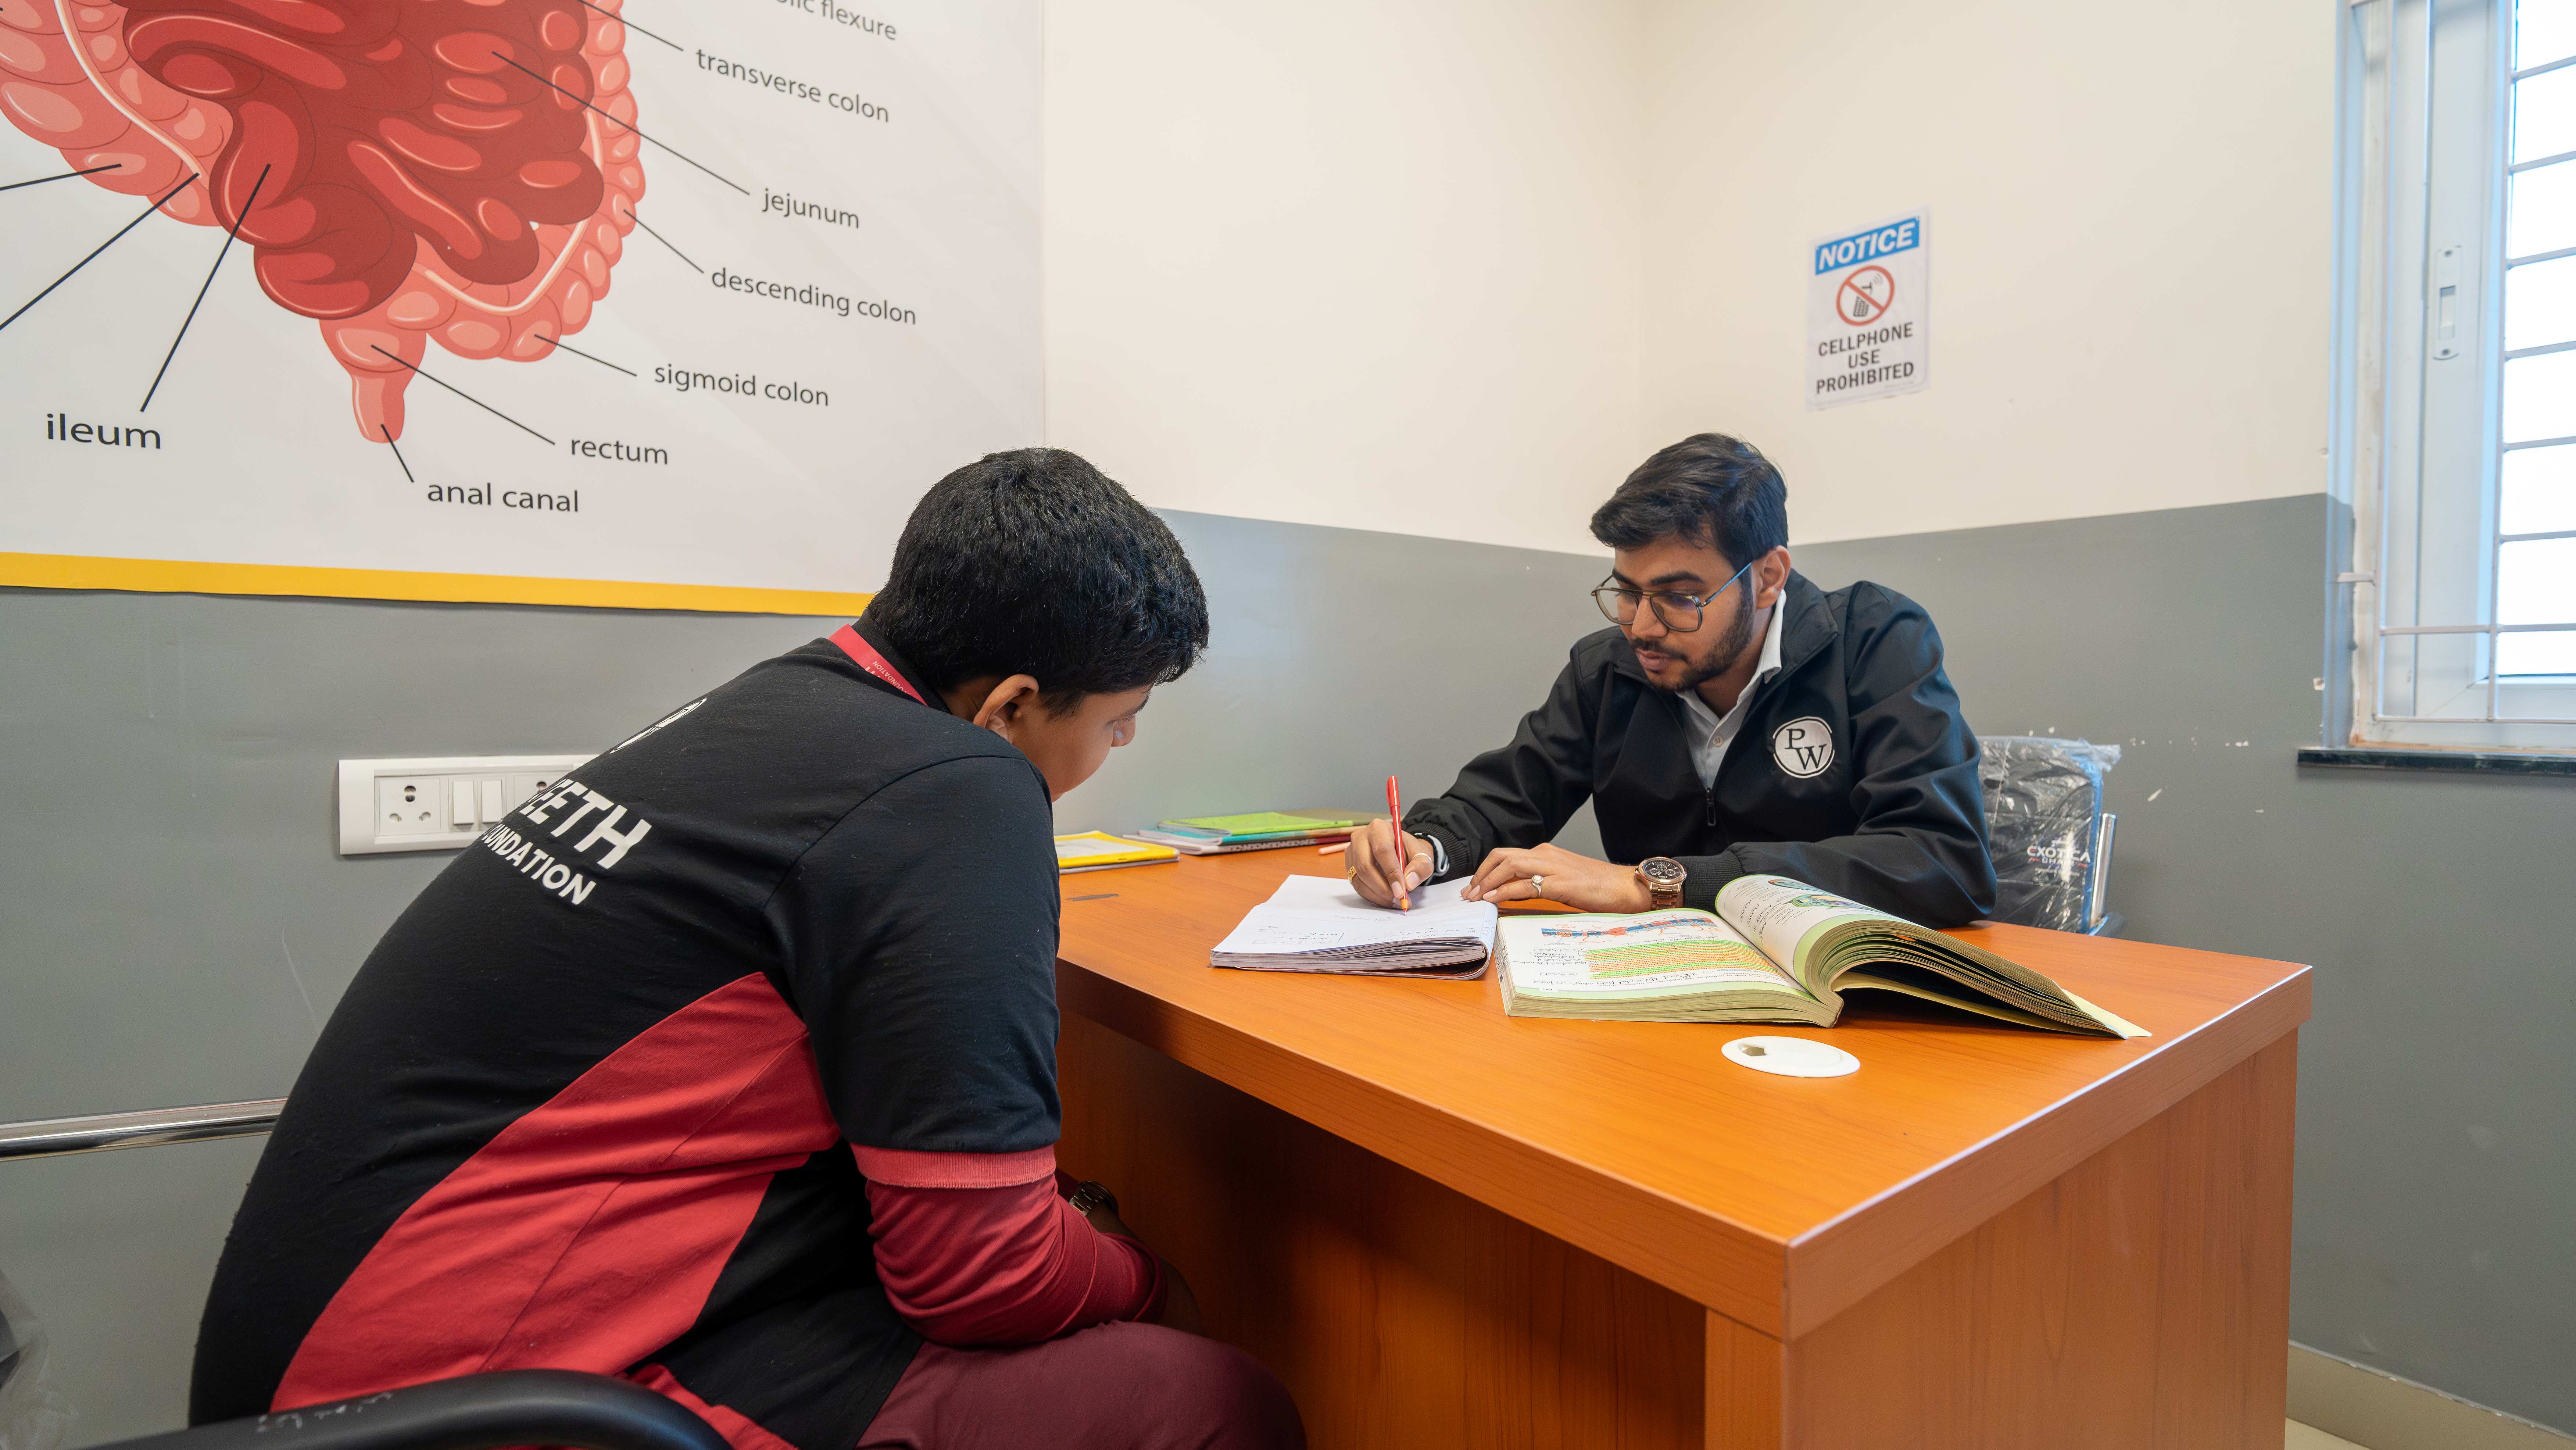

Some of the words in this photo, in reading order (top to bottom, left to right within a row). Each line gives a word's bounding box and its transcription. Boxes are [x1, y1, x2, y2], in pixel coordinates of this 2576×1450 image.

[820, 0, 897, 40] flexure
[695, 49, 822, 103] transverse
[828, 93, 889, 123] colon
[761, 187, 859, 229] jejunum
[1818, 222, 1915, 270] NOTICE
[711, 267, 850, 317] descending
[856, 299, 916, 325] colon
[1818, 322, 1914, 357] CELLPHONE
[1848, 349, 1881, 368] USE
[654, 363, 756, 397] sigmoid
[764, 381, 829, 407] colon
[1816, 361, 1914, 394] PROHIBITED
[46, 413, 161, 450] ileum
[571, 439, 668, 465] rectum
[427, 482, 492, 506] anal
[502, 489, 579, 513] canal
[872, 661, 906, 693] OUNDATION
[519, 778, 652, 869] EETH
[480, 823, 597, 906] OUNDATION
